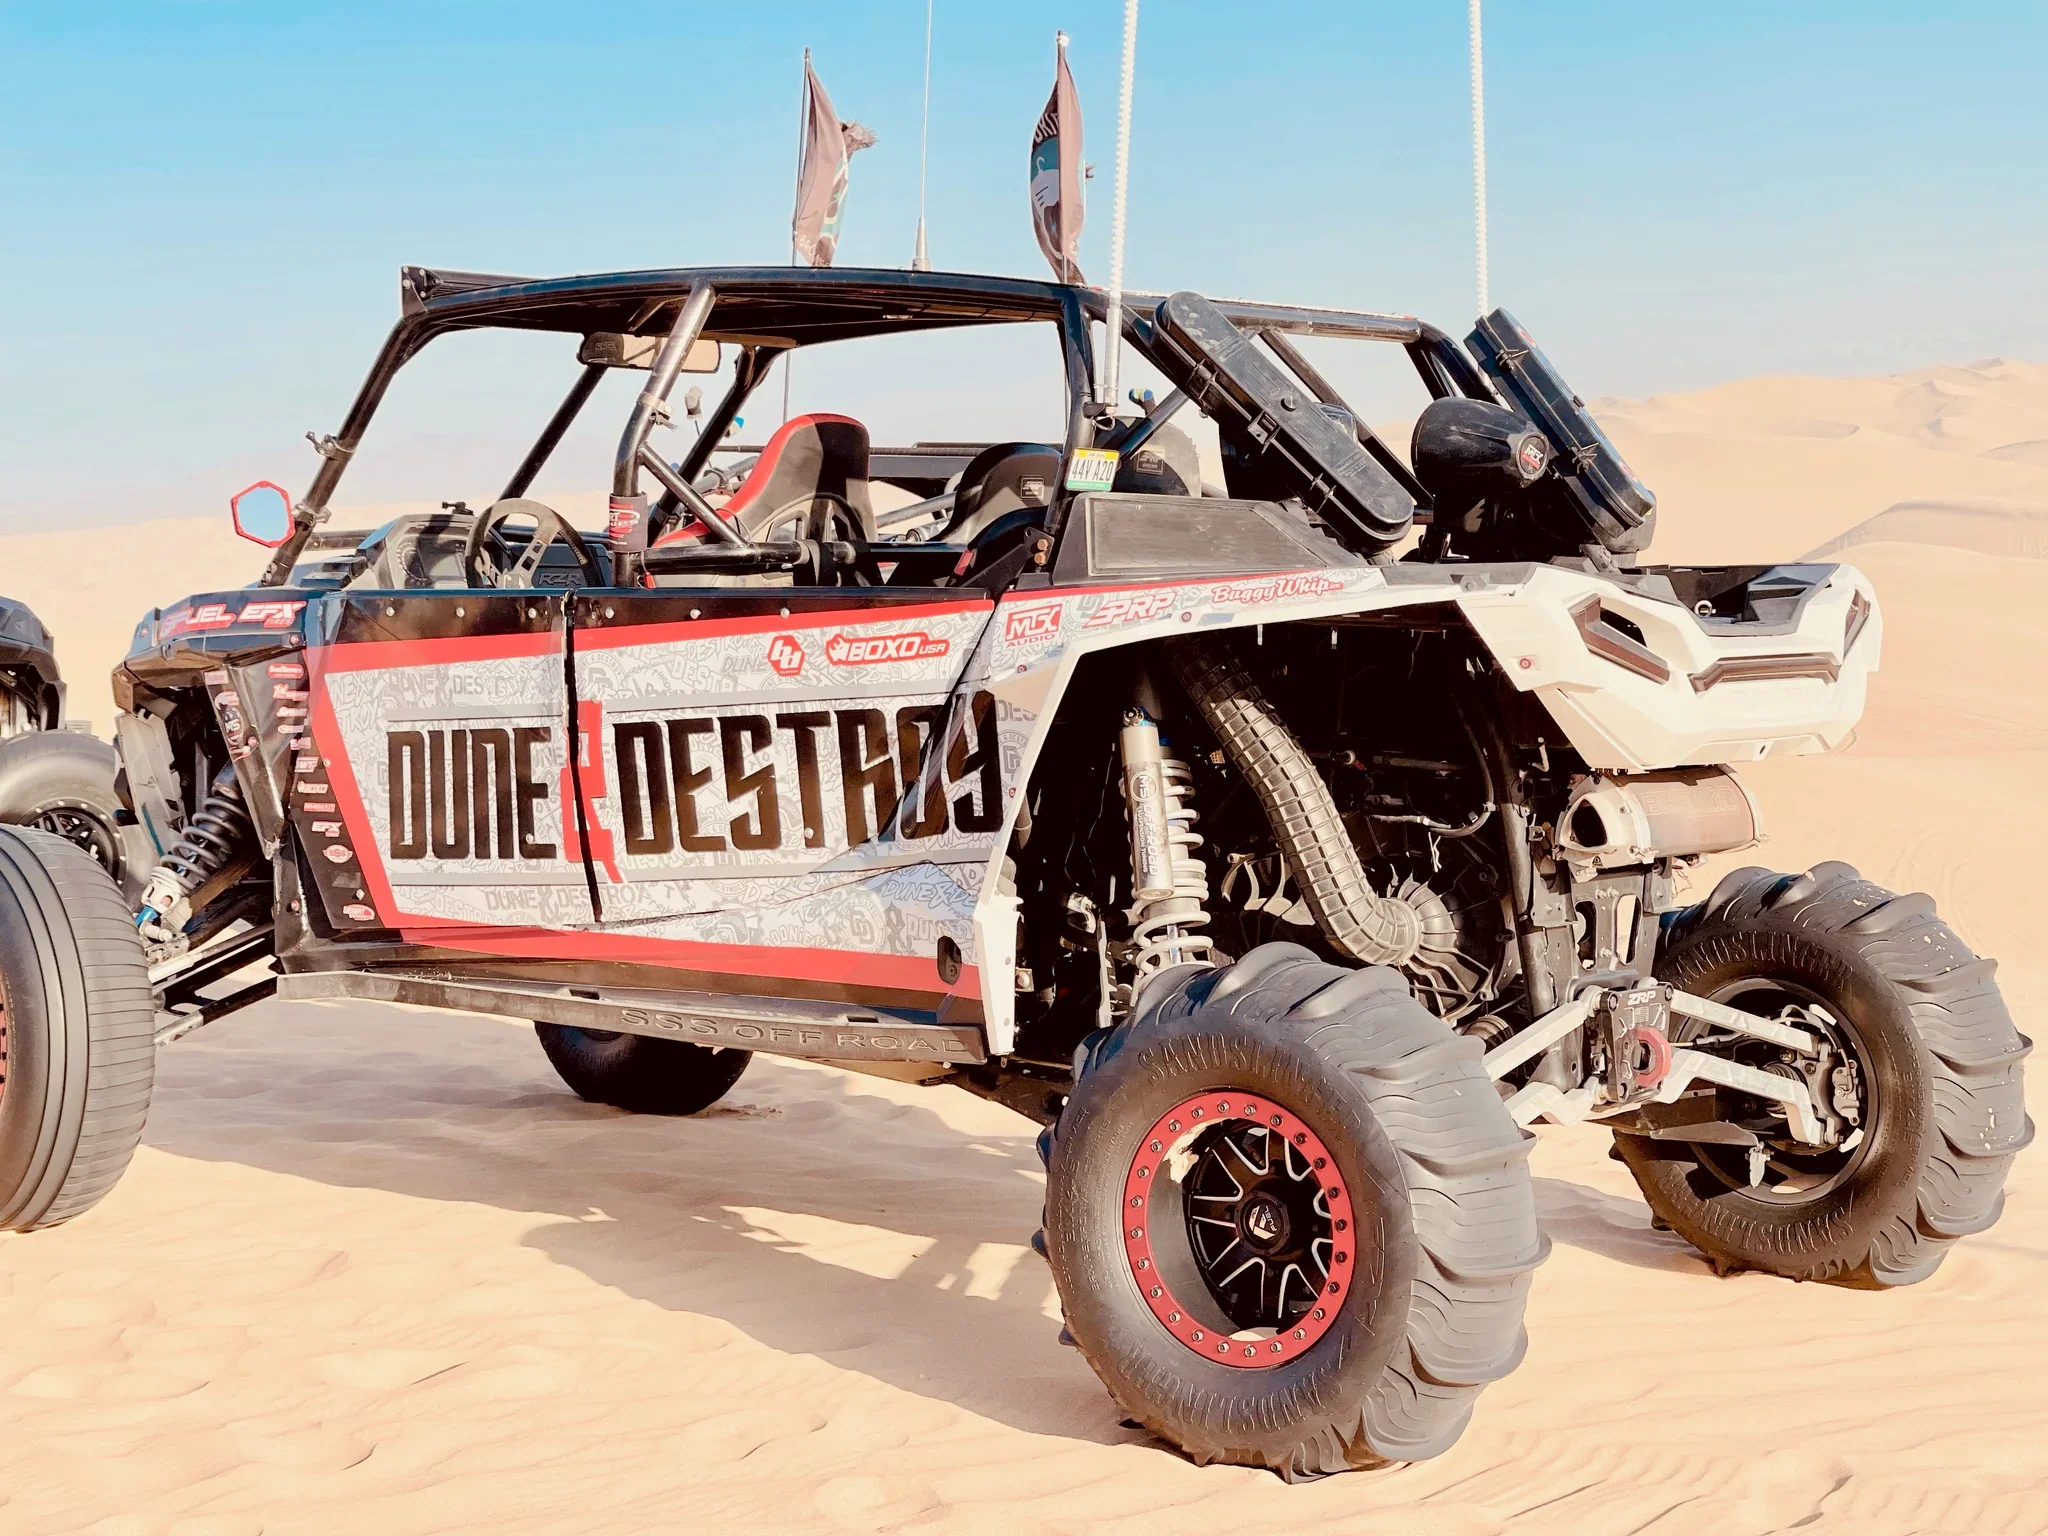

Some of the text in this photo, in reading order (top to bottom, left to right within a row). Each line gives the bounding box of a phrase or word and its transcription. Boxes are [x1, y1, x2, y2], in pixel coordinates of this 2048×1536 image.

[1071, 458, 1115, 482] 44V A20
[538, 573, 582, 587] RZR
[1212, 585, 1276, 604] Buggy
[1275, 576, 1329, 597] Whip
[240, 602, 304, 620] EFX
[1006, 606, 1062, 640] MTX
[848, 637, 946, 662] BOXO USA
[1006, 634, 1056, 649] AUDIO
[386, 727, 557, 860] DUNE
[1628, 990, 1656, 1006] ZRP
[620, 1007, 970, 1053] SSS OFF ROAD
